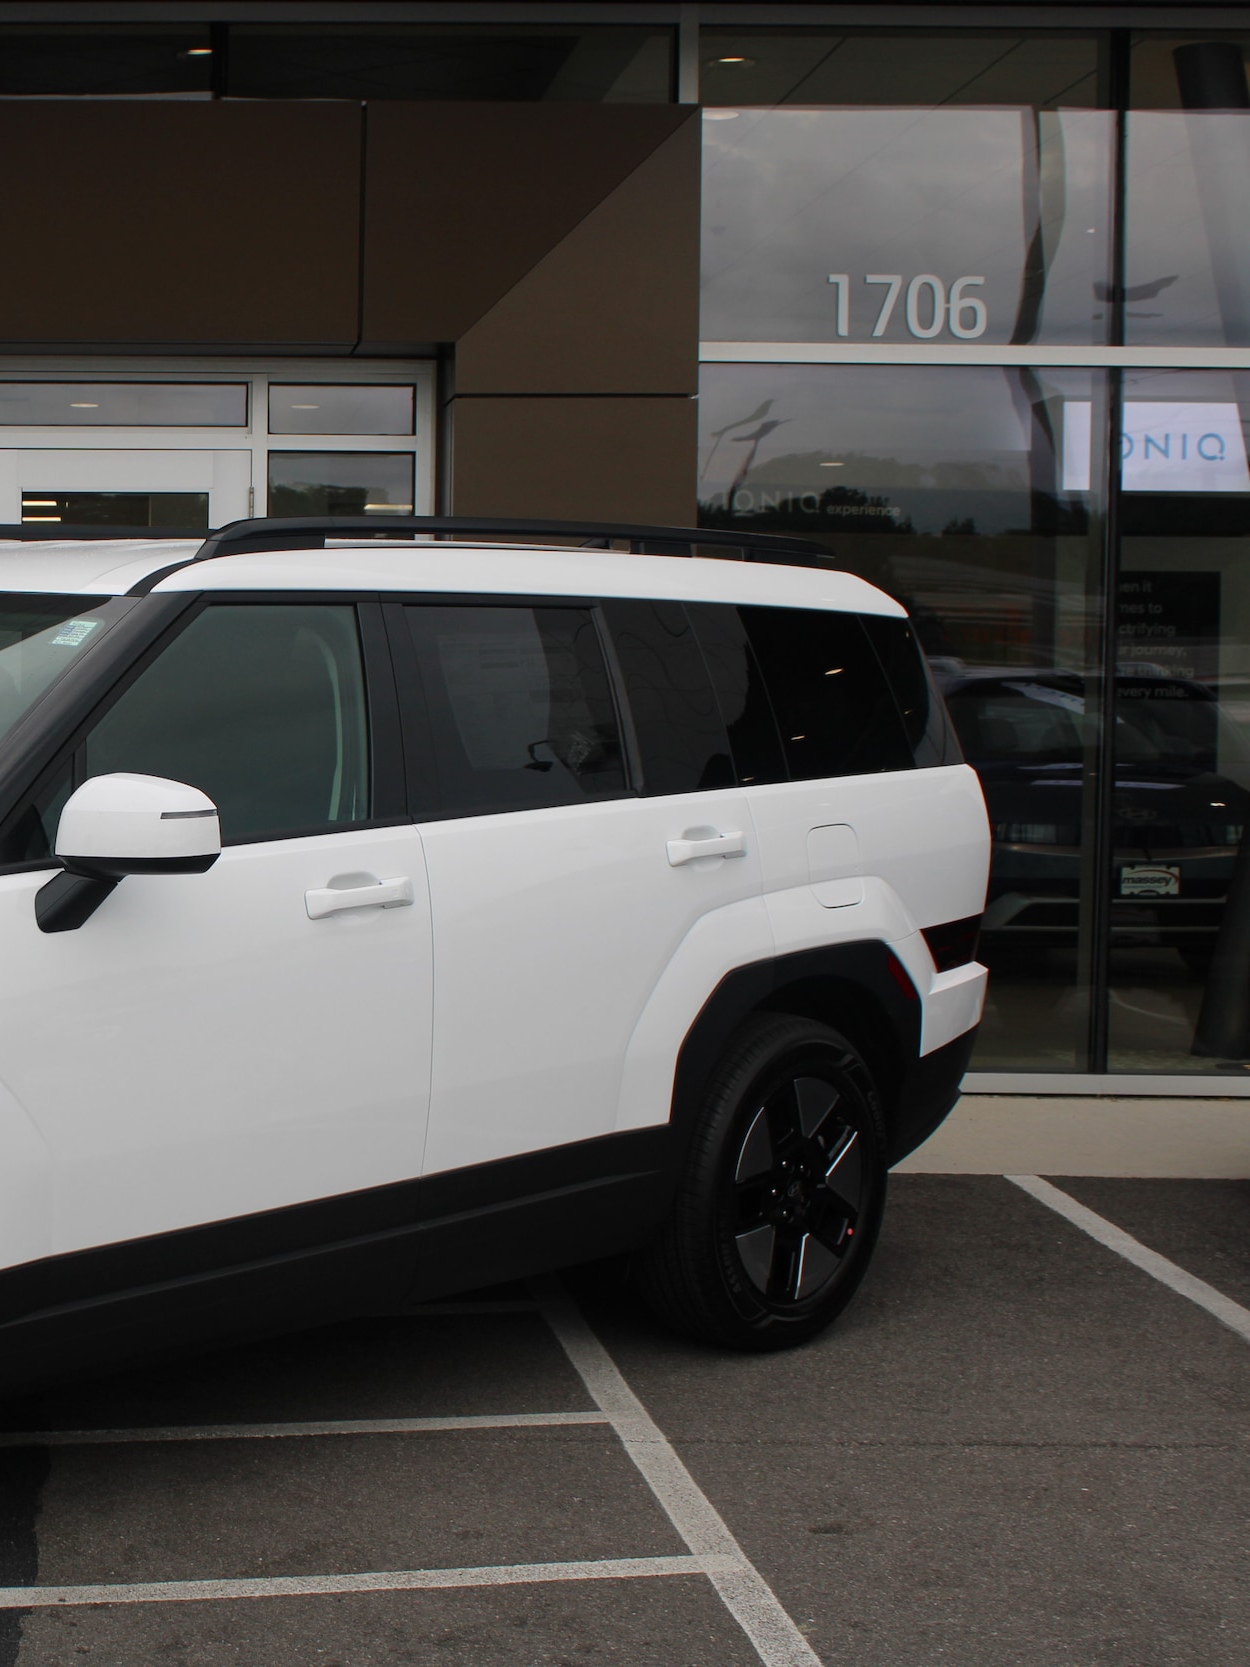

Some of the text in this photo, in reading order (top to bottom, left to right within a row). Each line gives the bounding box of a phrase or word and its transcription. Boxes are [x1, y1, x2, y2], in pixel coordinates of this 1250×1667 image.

[827, 274, 988, 339] 1706
[826, 503, 901, 517] experience
[1148, 601, 1163, 614] to
[1122, 876, 1173, 887] massey
